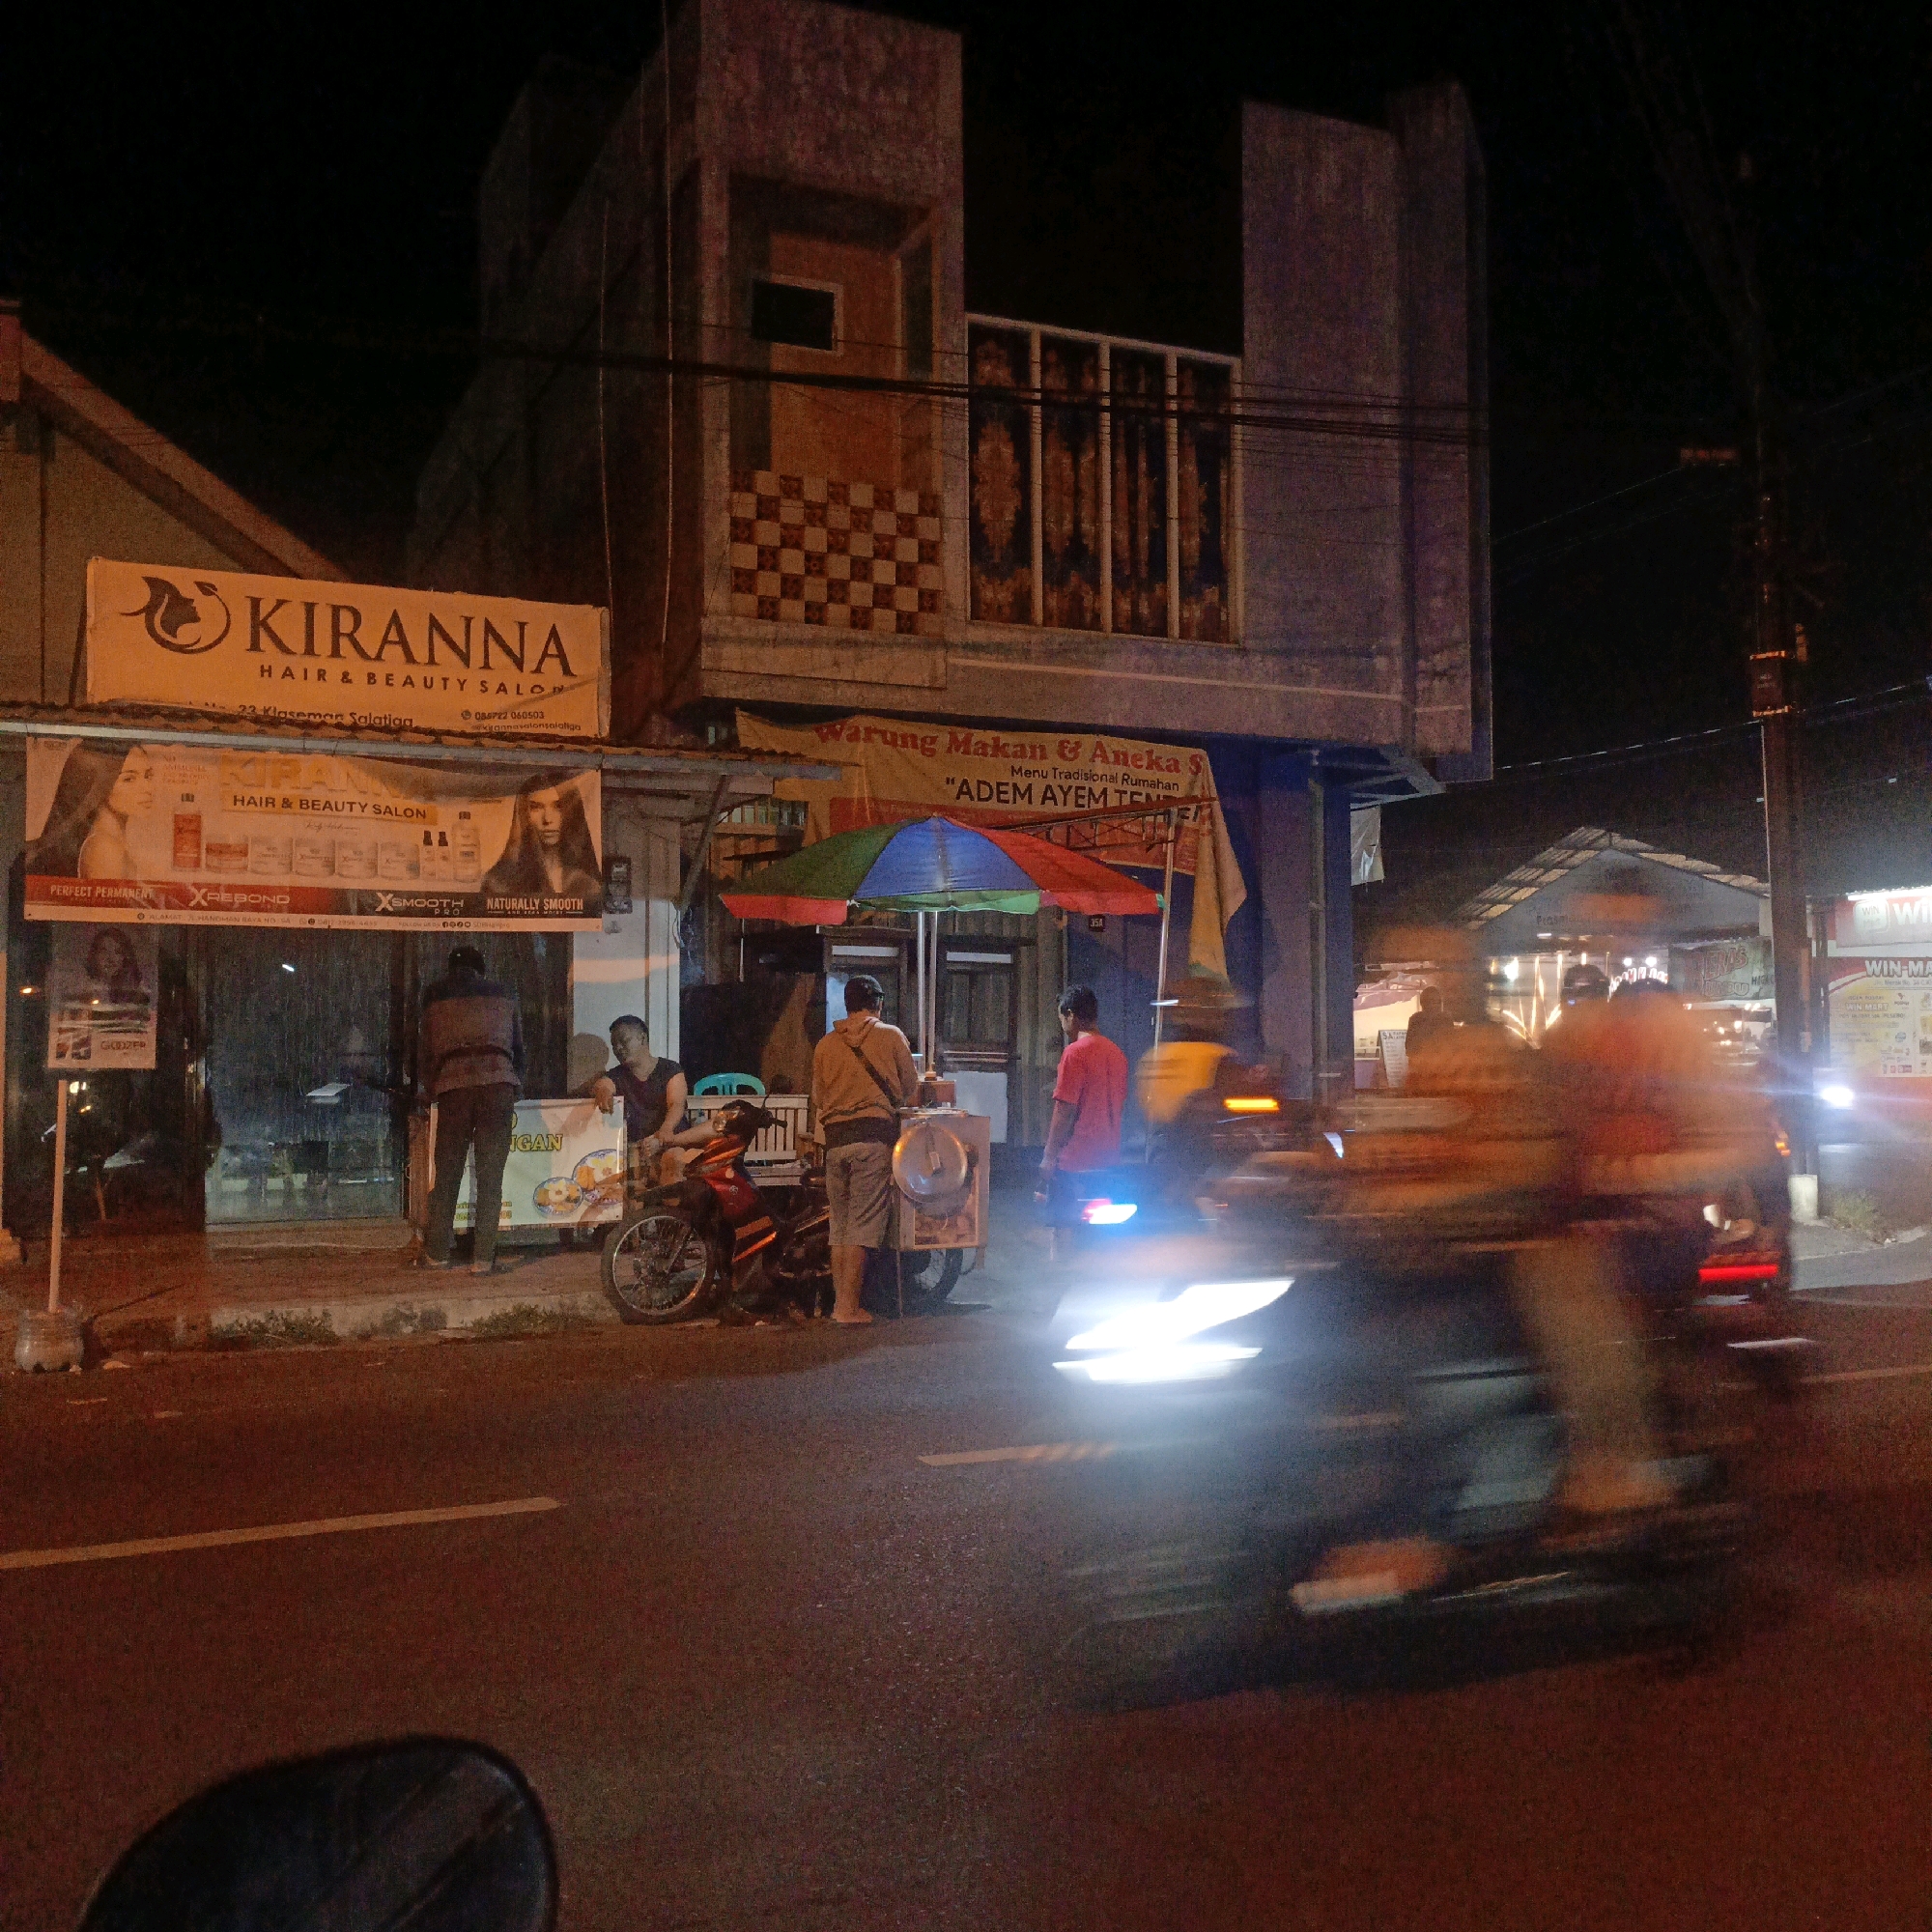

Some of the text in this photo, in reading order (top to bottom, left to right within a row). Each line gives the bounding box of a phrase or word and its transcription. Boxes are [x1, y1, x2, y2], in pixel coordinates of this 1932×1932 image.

[244, 595, 579, 678] KIRANNA
[259, 664, 565, 696] HAIR & BEAUTY SALON
[813, 721, 939, 757] Warung
[946, 728, 1048, 761] Makan
[1056, 739, 1083, 762] &
[1089, 740, 1181, 774] Aneka
[1010, 765, 1179, 791] Menu Tradisional Rumahan
[233, 795, 427, 819] HAIR & BEAUTY SALON
[1039, 784, 1108, 809] AYEM
[50, 885, 155, 901] PERFECT PERMANENT
[486, 896, 583, 910] NATURALLY SMOOTH
